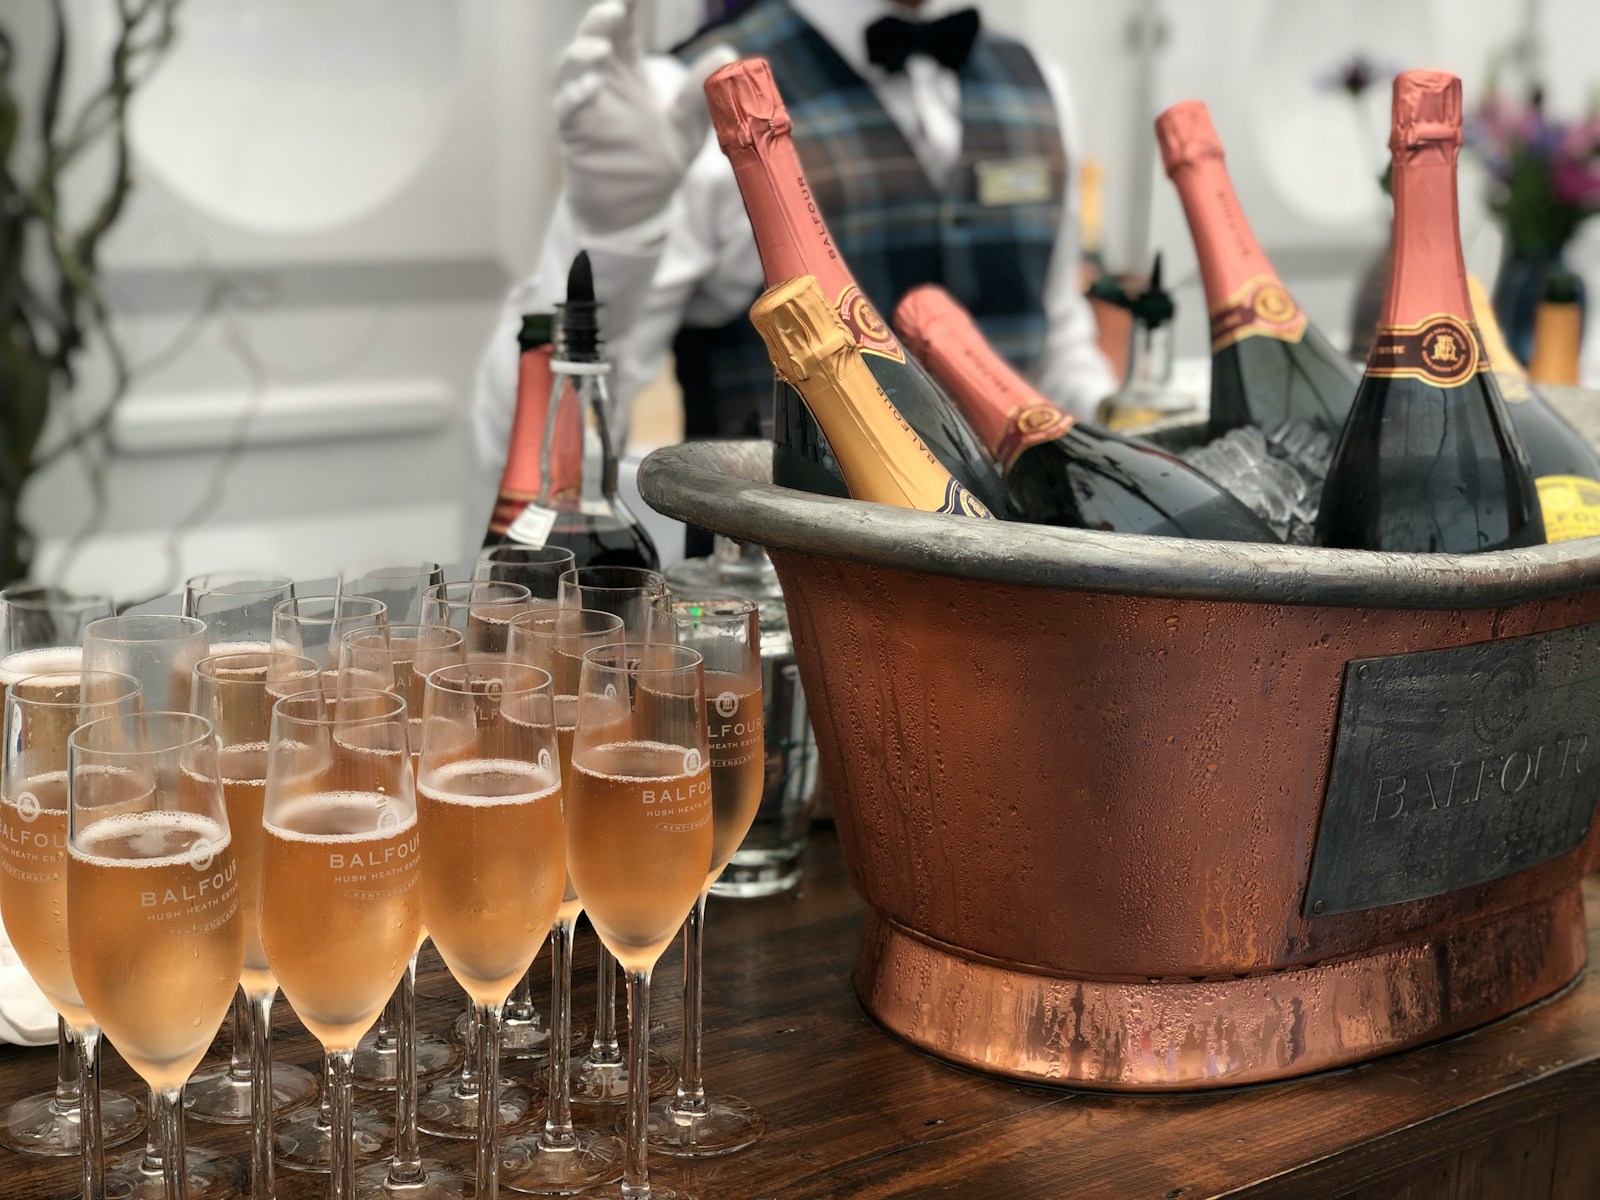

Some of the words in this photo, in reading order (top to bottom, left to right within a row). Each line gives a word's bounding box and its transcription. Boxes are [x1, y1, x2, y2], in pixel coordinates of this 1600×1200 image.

[797, 176, 837, 260] BALFOUR
[707, 717, 762, 738] LFOUR
[709, 742, 738, 750] HEATH
[1371, 734, 1589, 822] BALFOUR
[642, 777, 712, 804] BALFOU
[646, 808, 675, 817] HUSH
[678, 803, 702, 814] HEATH
[0, 822, 67, 849] ALFOU
[10, 848, 39, 861] HEATH
[140, 858, 237, 908] BALFOUR
[334, 875, 367, 883] HUSH
[371, 867, 403, 880] HEATH
[147, 911, 181, 921] HUSH
[186, 897, 219, 914] HEATH
